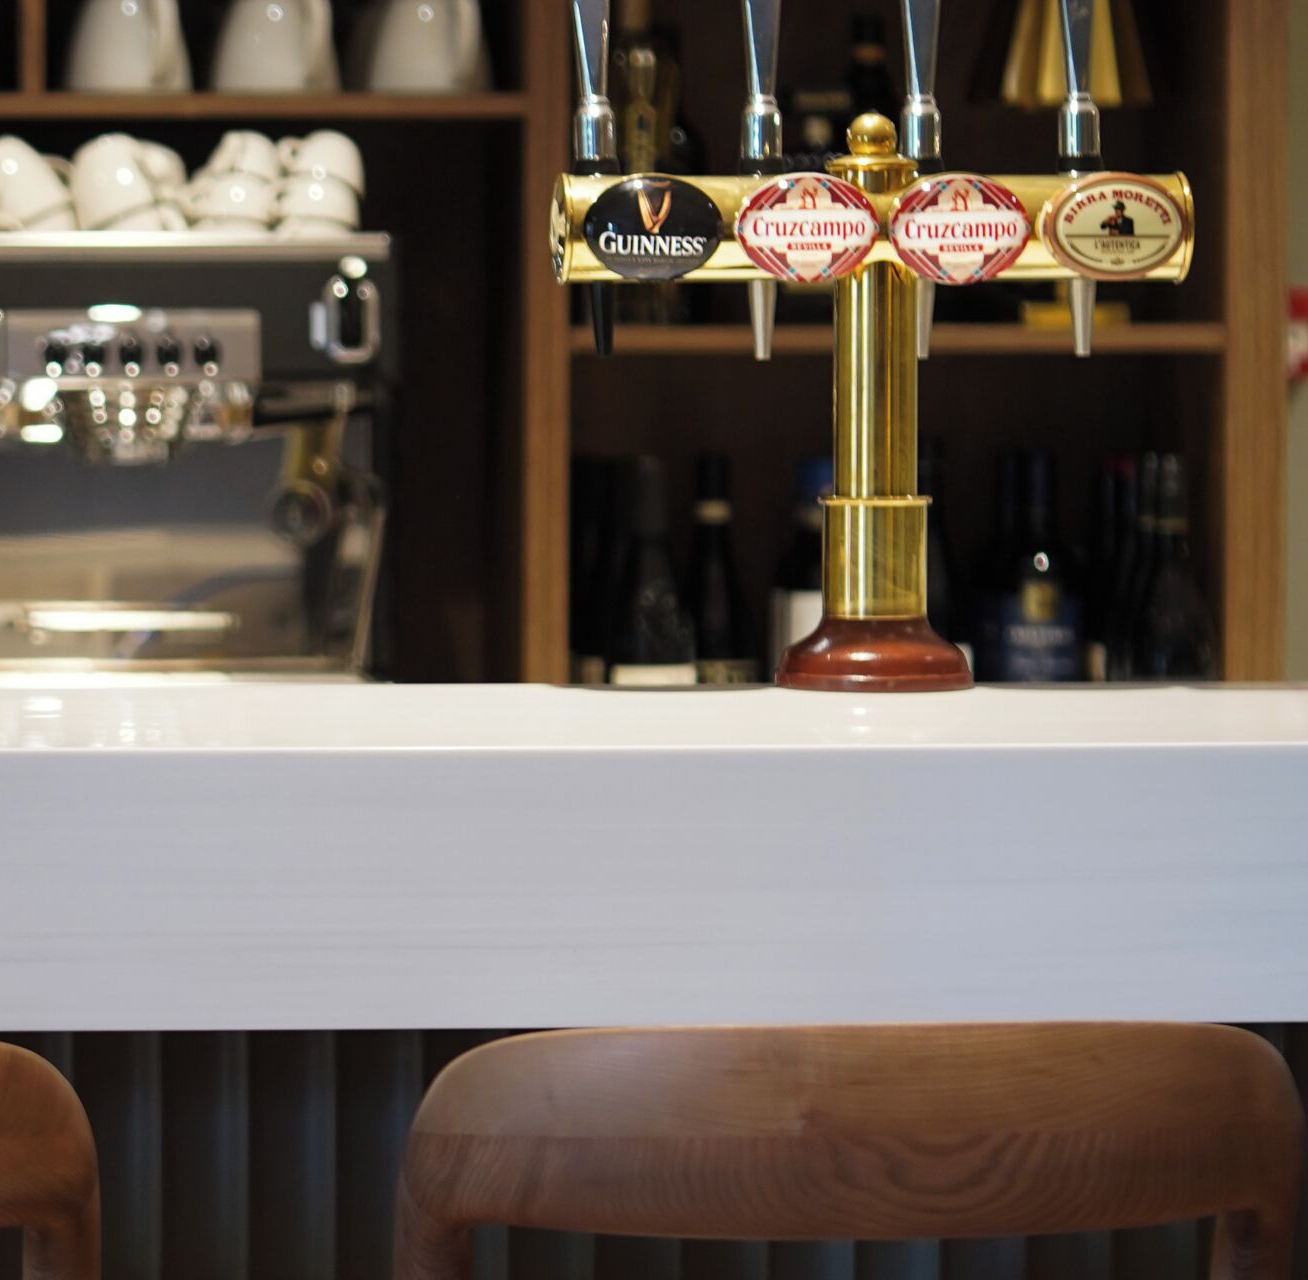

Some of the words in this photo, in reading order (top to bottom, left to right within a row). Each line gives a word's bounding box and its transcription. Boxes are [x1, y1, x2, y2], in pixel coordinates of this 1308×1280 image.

[1063, 191, 1108, 225] BIRRA
[752, 215, 866, 240] Cruzcampo
[904, 218, 1018, 241] Cruzcampo
[598, 230, 705, 257] GUINNESS
